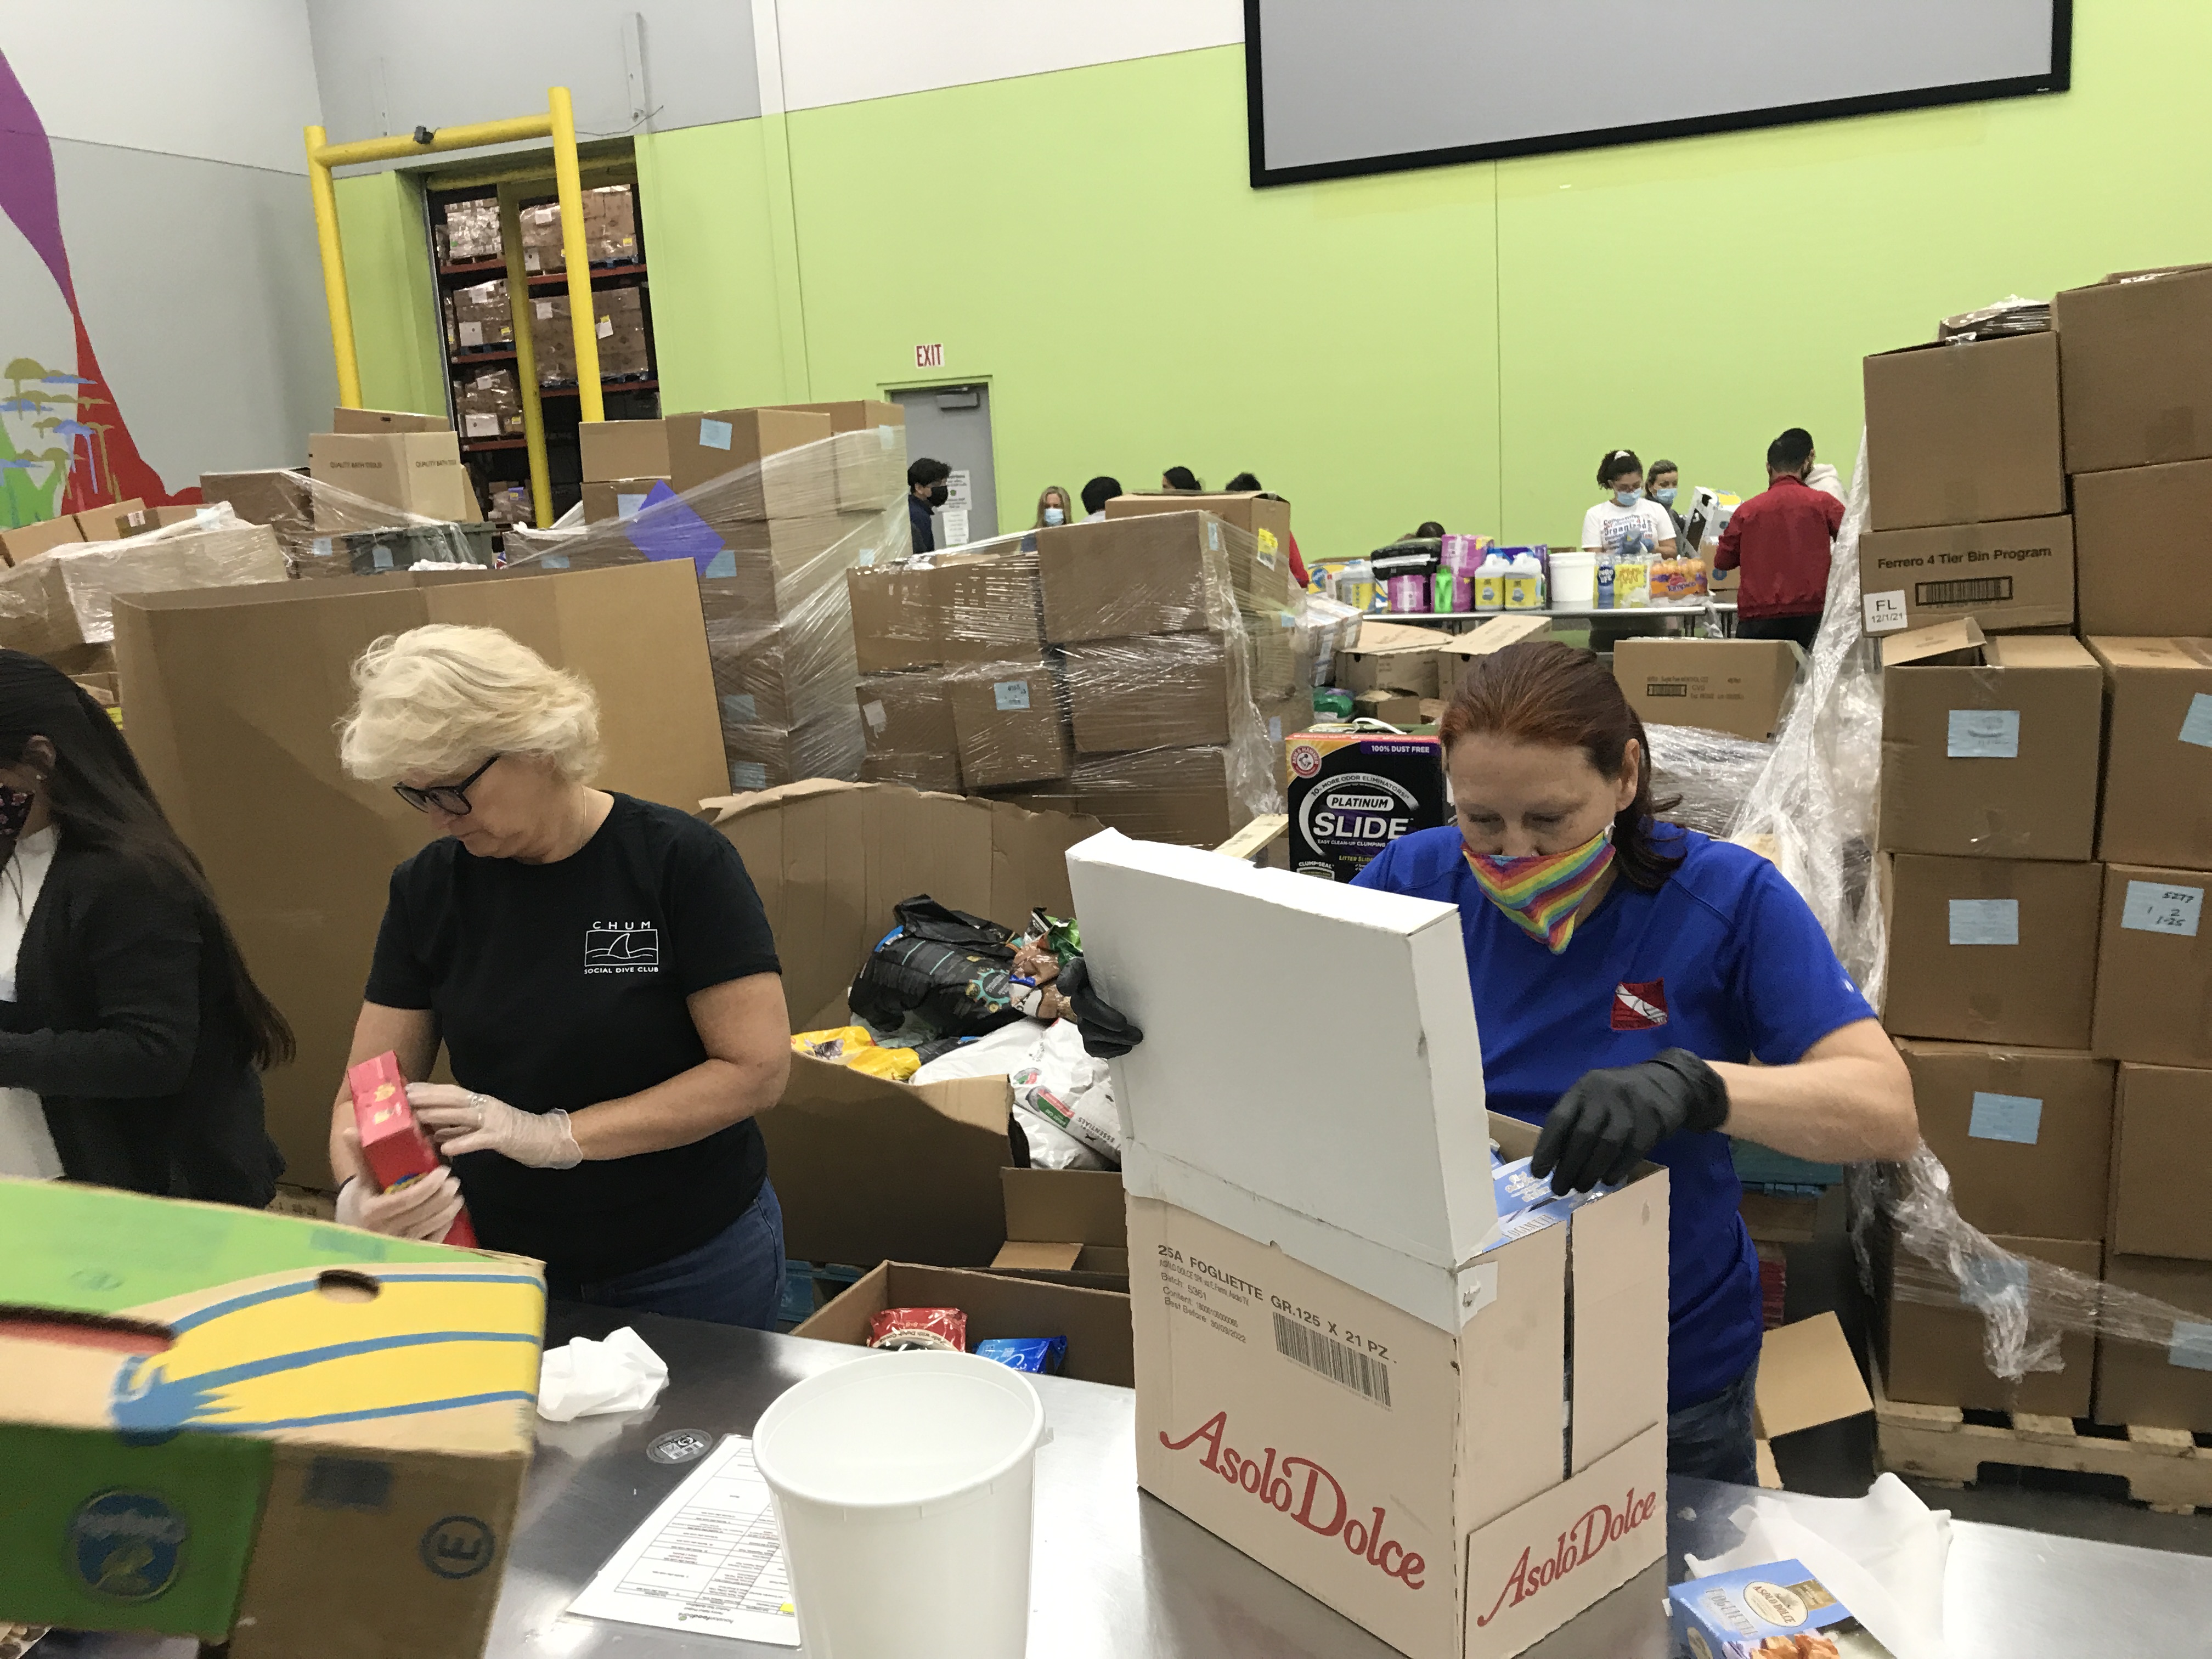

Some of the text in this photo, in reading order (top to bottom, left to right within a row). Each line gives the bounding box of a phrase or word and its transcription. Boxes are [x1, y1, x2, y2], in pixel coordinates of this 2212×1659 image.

[916, 343, 942, 367] EXIT
[1877, 548, 2052, 569] Ferrero 4 Tier Bin Program
[1876, 599, 1897, 612] FL
[1871, 612, 1904, 624] 12/1/21
[1371, 744, 1390, 753] 100%
[1321, 777, 1340, 789] MORE
[1331, 797, 1389, 809] PLATINUM
[1313, 812, 1408, 840] SLIDE
[1158, 1244, 1184, 1263] 25A
[1189, 1256, 1263, 1301] FOGLIETTE
[1270, 1294, 1321, 1328] GR.125
[1327, 1321, 1339, 1337] X
[1345, 1330, 1362, 1347] 21
[1164, 1296, 1181, 1310] Best
